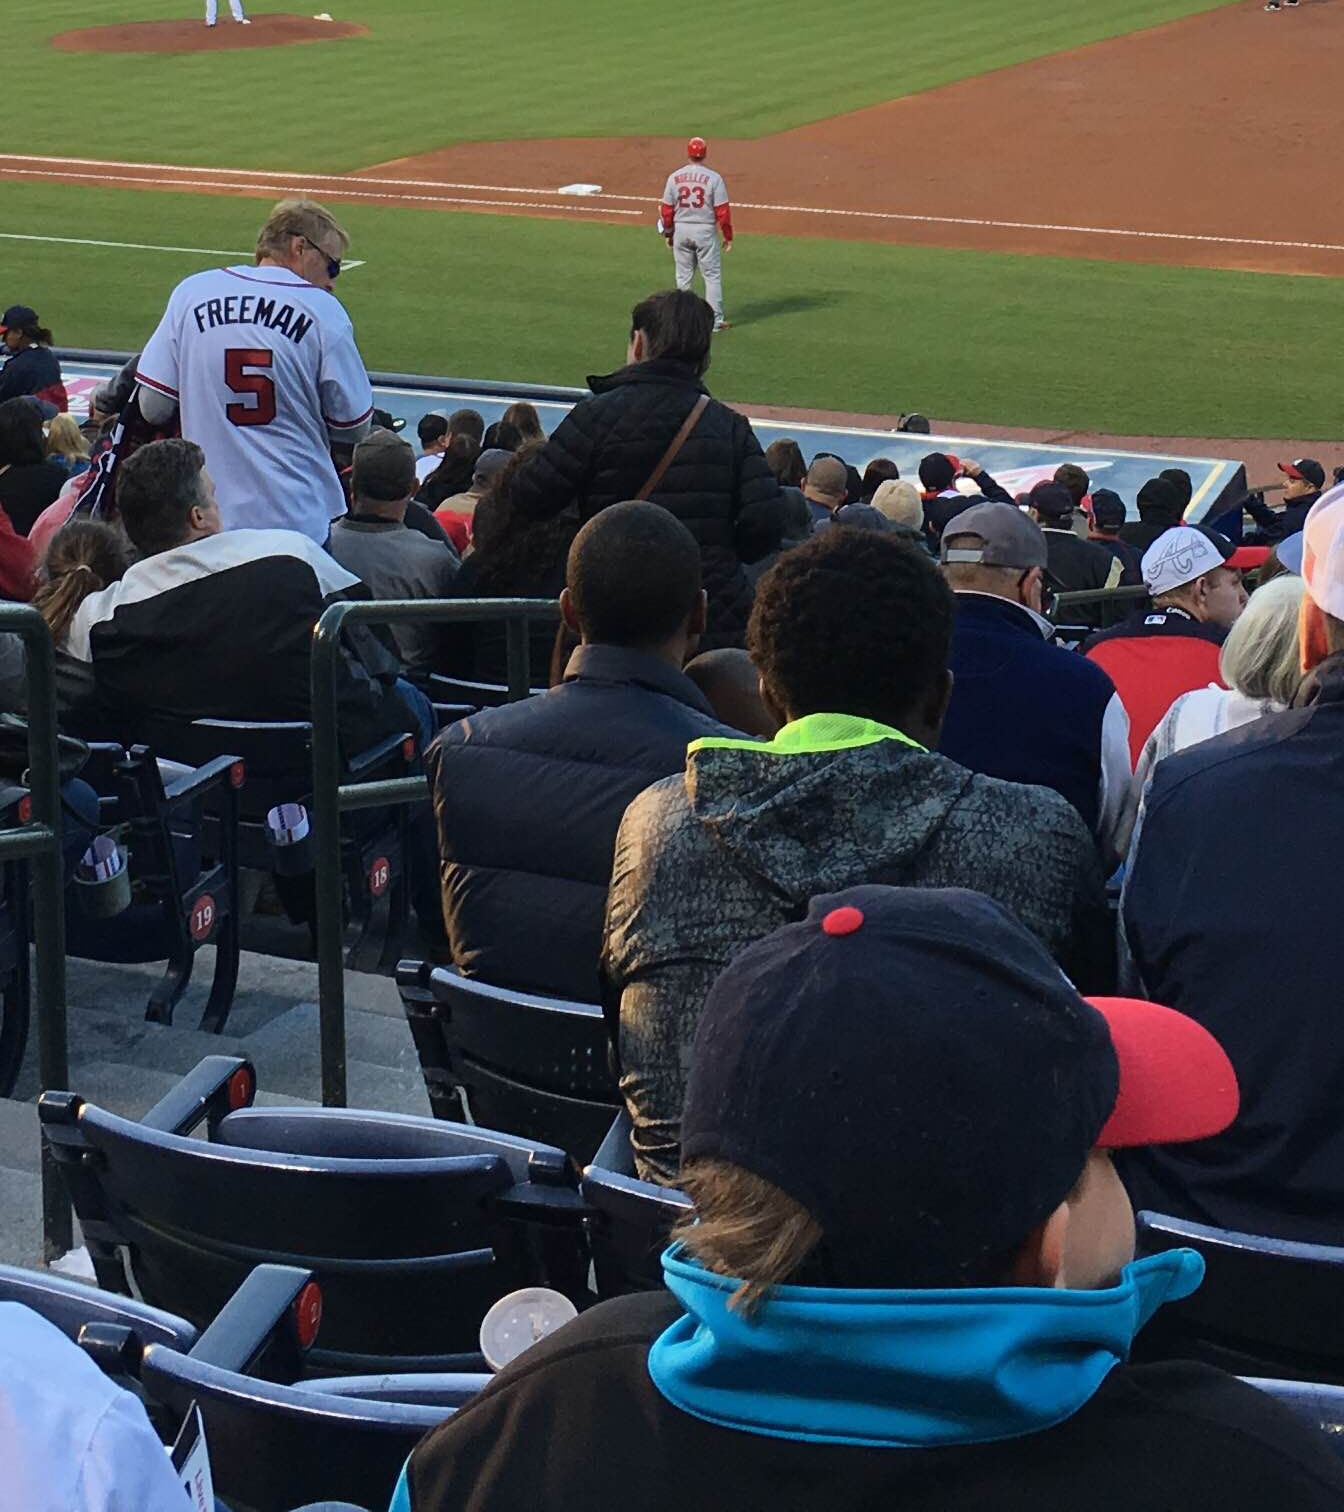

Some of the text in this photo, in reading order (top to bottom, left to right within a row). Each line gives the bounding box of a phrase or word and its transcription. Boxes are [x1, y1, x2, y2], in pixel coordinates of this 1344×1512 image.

[677, 185, 705, 209] 23
[193, 295, 314, 345] FREEMAN
[224, 348, 277, 427] 5
[373, 865, 387, 889] 18
[194, 905, 211, 931] 19
